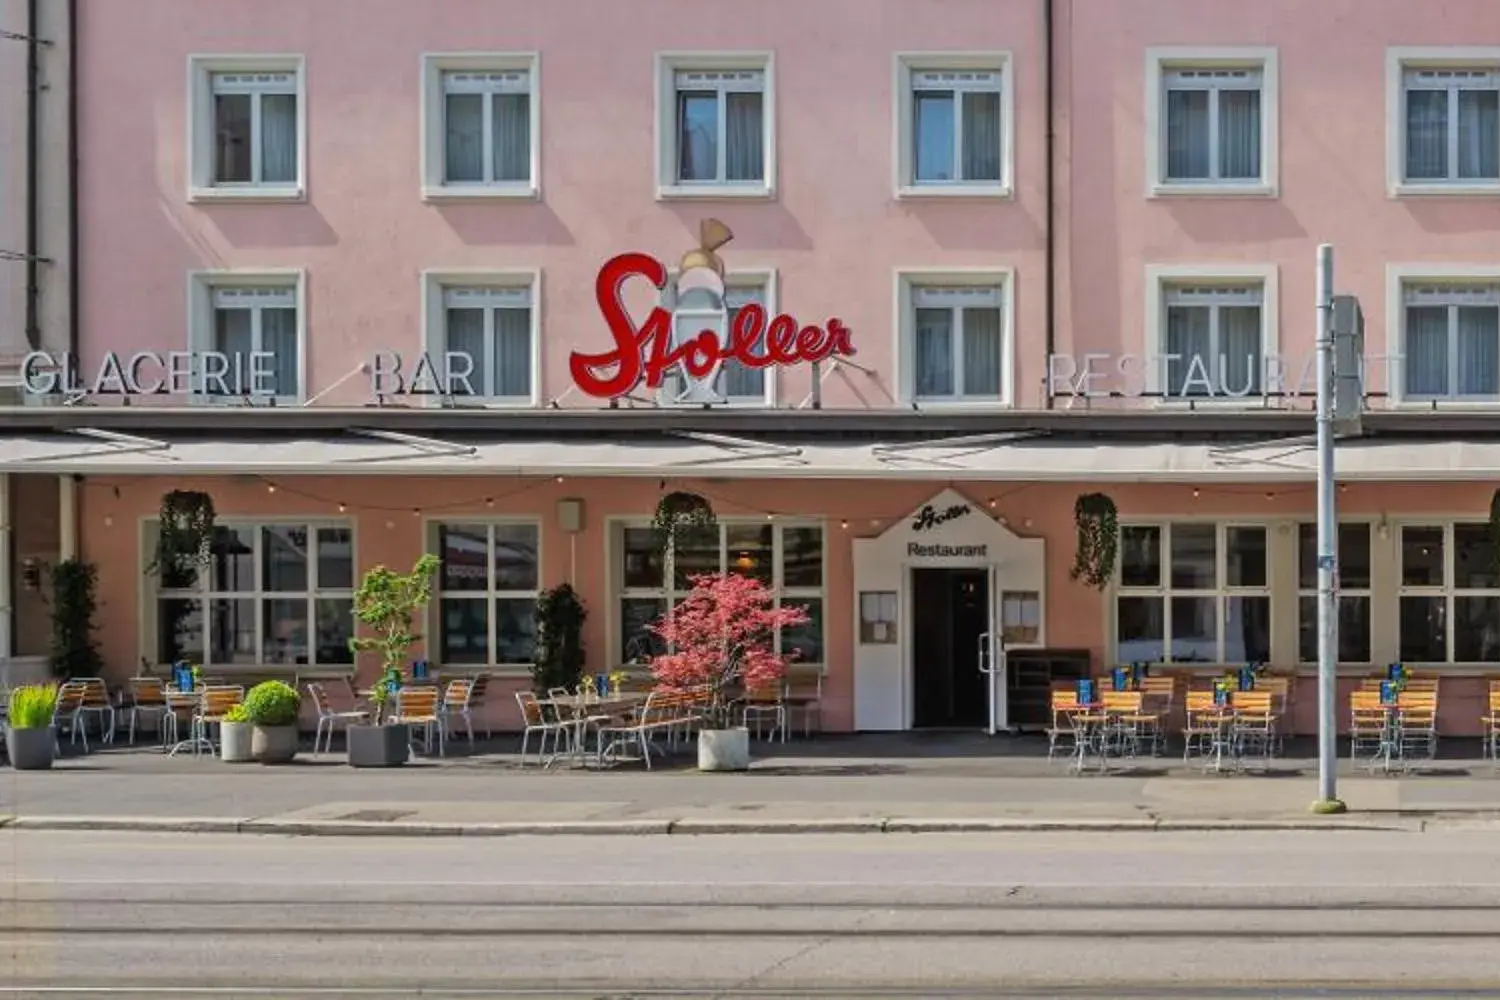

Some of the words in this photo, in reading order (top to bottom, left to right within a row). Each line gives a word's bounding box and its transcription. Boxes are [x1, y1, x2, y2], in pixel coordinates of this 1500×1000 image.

[569, 251, 858, 398] Stoller
[20, 350, 277, 395] GLACERIE
[369, 350, 477, 396] BAR
[1049, 353, 1406, 398] RESTAURAT
[906, 542, 987, 557] Restaurant
